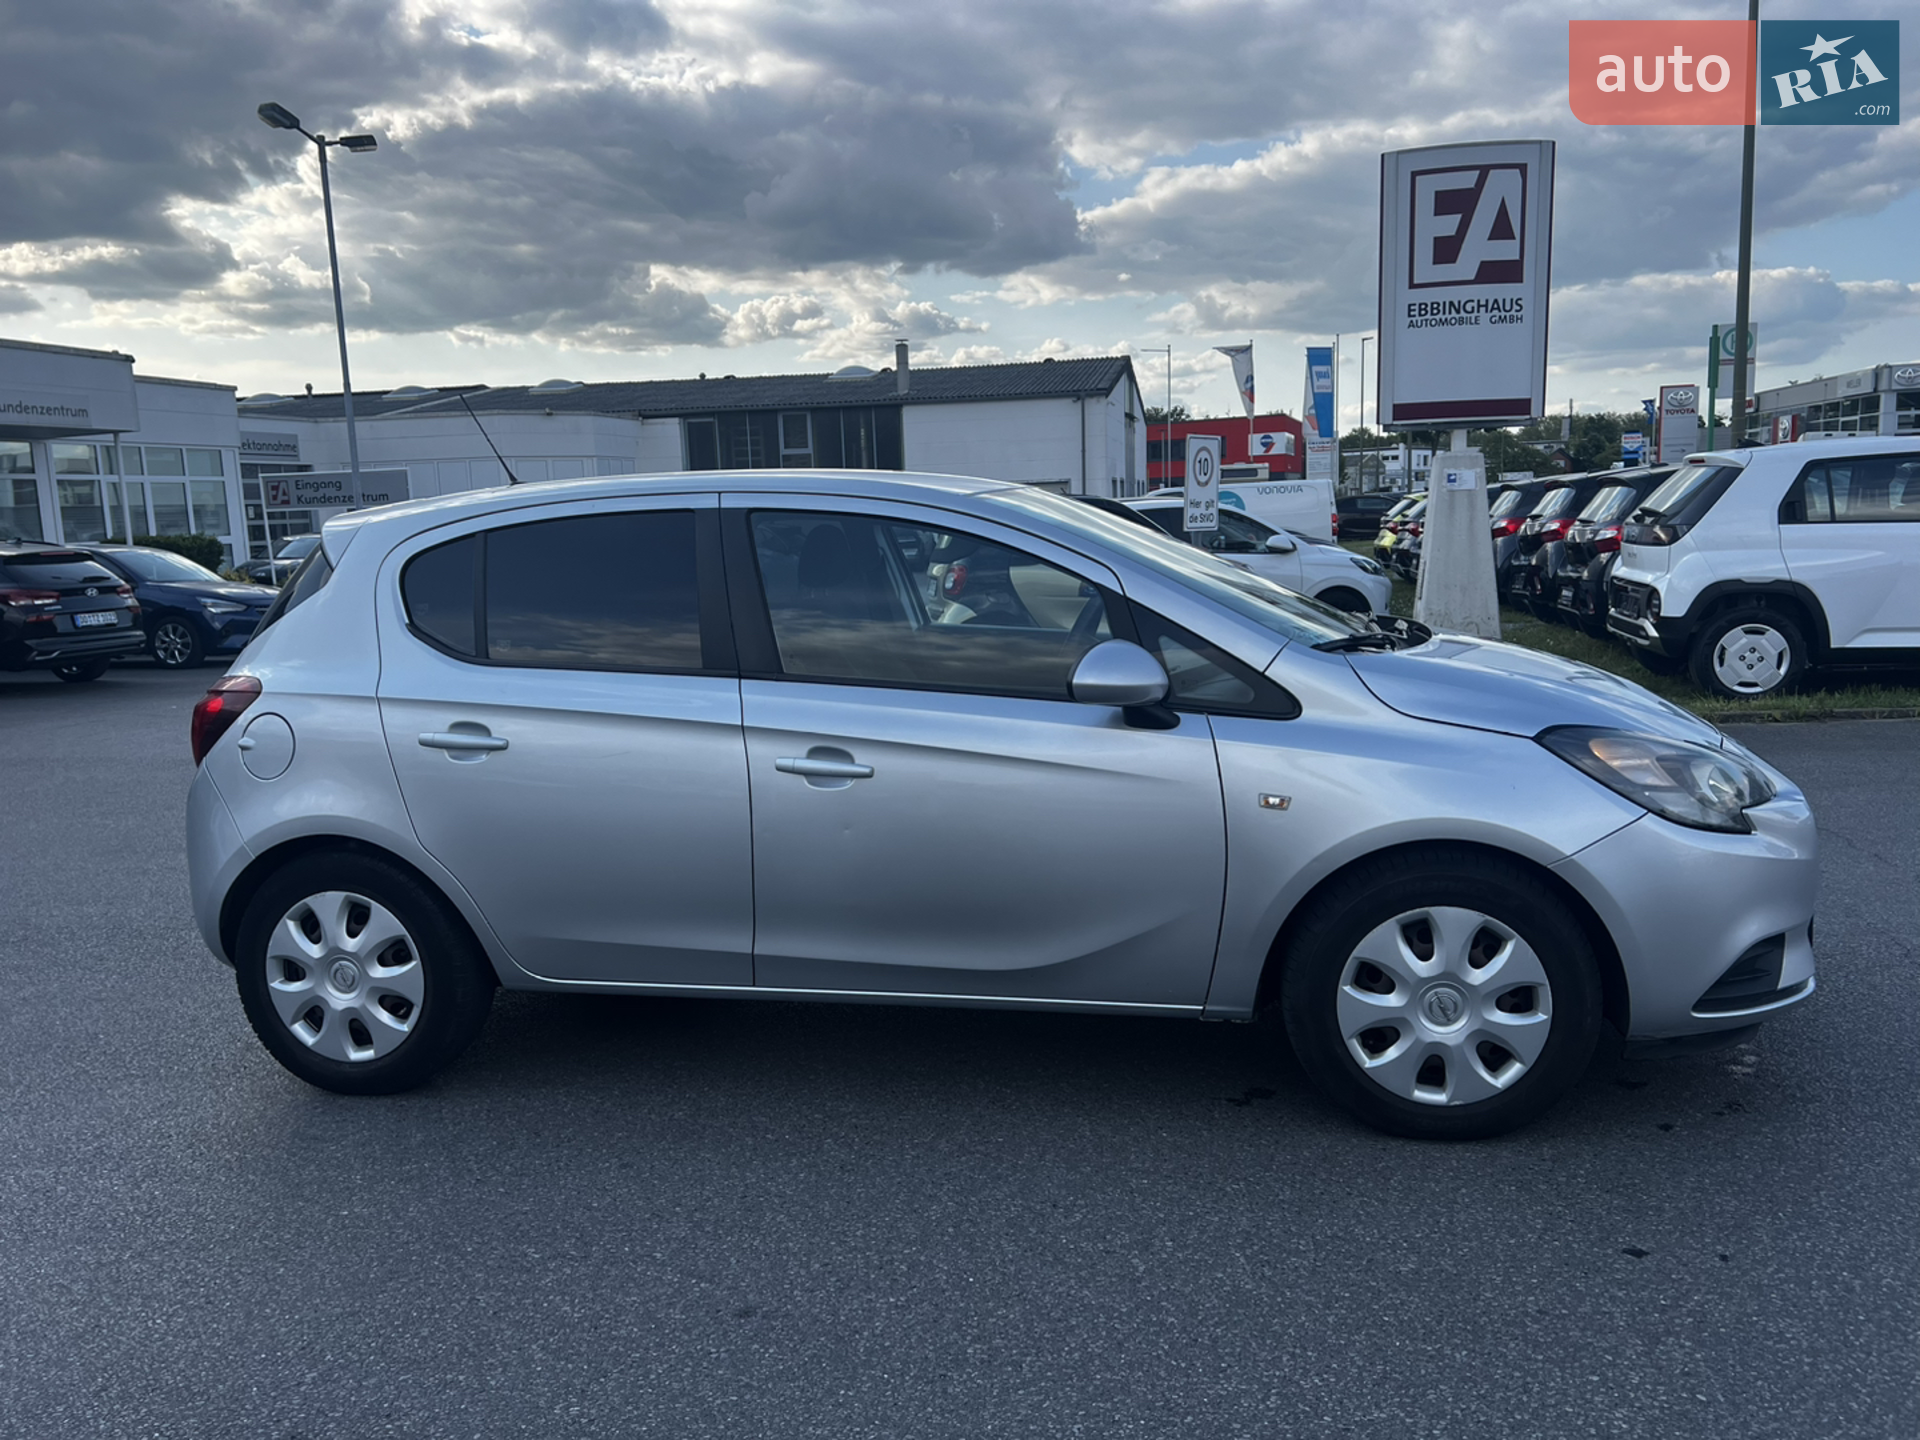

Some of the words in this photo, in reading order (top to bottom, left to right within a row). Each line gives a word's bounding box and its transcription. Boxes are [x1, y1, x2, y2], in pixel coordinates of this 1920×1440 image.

[1407, 298, 1523, 318] EBBINGHAUS
[1407, 315, 1481, 329] AUTOMOBILE
[0, 400, 89, 419] undenzentrum
[1665, 408, 1696, 416] TOYOTA
[241, 438, 298, 453] ektannahme
[1198, 457, 1209, 477] 10
[295, 480, 342, 492] Eingang
[296, 492, 389, 505] Kundenzetrum
[1189, 498, 1202, 509] Hier
[1205, 498, 1215, 511] gilt
[1189, 512, 1198, 523] die
